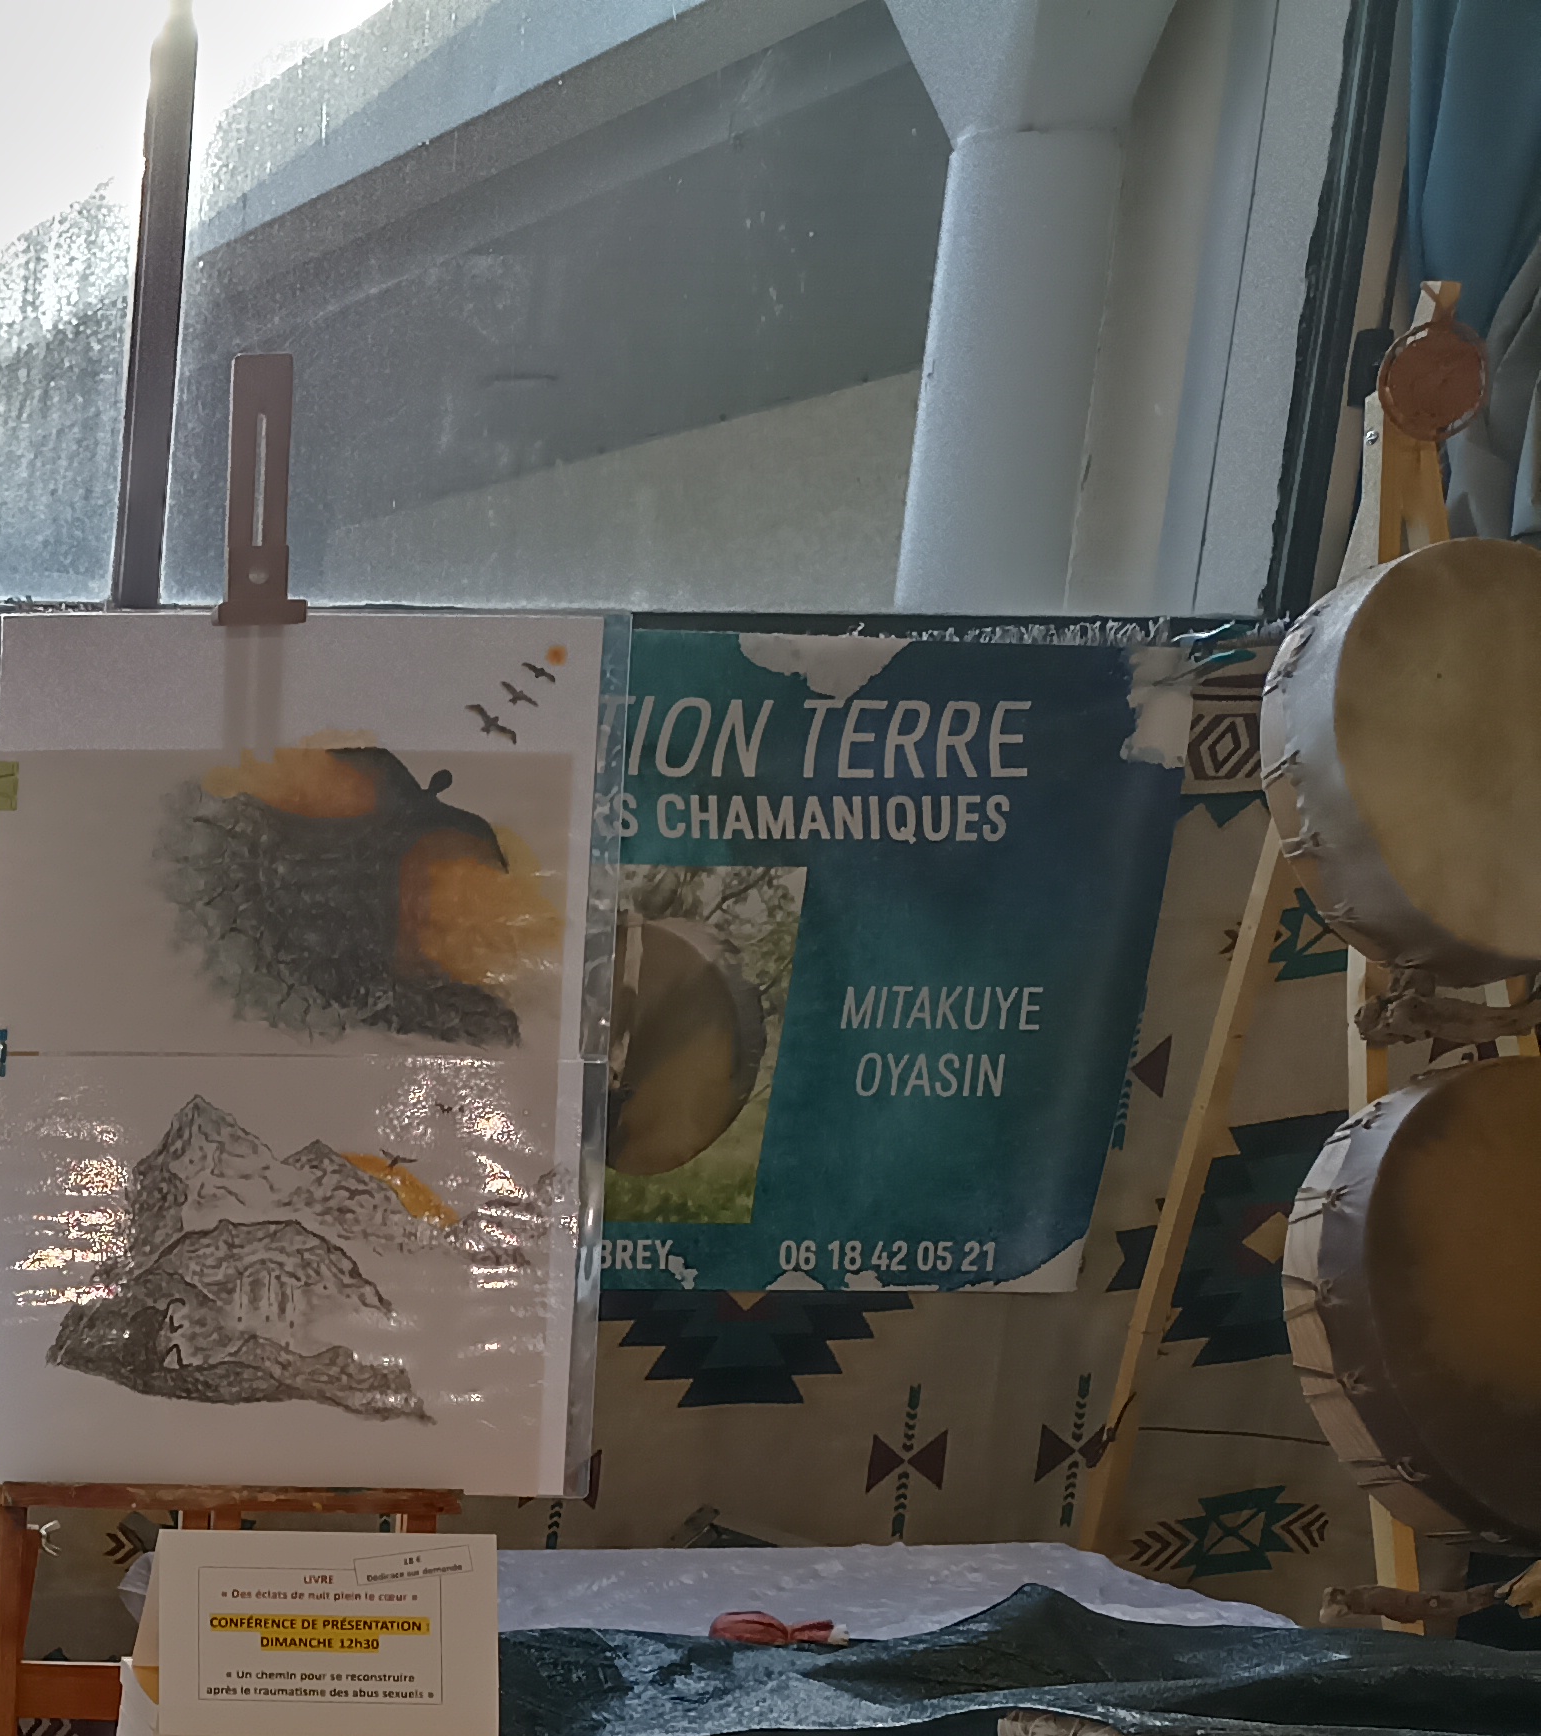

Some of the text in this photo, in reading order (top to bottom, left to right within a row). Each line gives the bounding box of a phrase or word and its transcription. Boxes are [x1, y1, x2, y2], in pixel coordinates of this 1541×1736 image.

[802, 699, 1032, 779] TERRE
[656, 794, 1010, 844] CHAMANIQUES
[840, 985, 1044, 1031] MITAKUYE
[855, 1053, 1006, 1098] OYASIN
[778, 1240, 817, 1271] 06
[826, 1240, 863, 1271] 18
[870, 1240, 908, 1271] 42
[916, 1241, 953, 1271] 05
[960, 1241, 996, 1272] 21
[303, 1575, 335, 1585] LIVRE
[231, 1589, 252, 1599] Des
[254, 1589, 288, 1600] éclats
[292, 1589, 305, 1600] de
[308, 1589, 331, 1600] nuit
[210, 1614, 422, 1632] CONFÉRENCE DE PRÉSENTATION
[261, 1635, 380, 1651] DIMANCHE 12h30
[236, 1669, 415, 1683] Un chemin pour se reconstruire
[206, 1686, 424, 1699] après le traumatisme des abus sexuels
